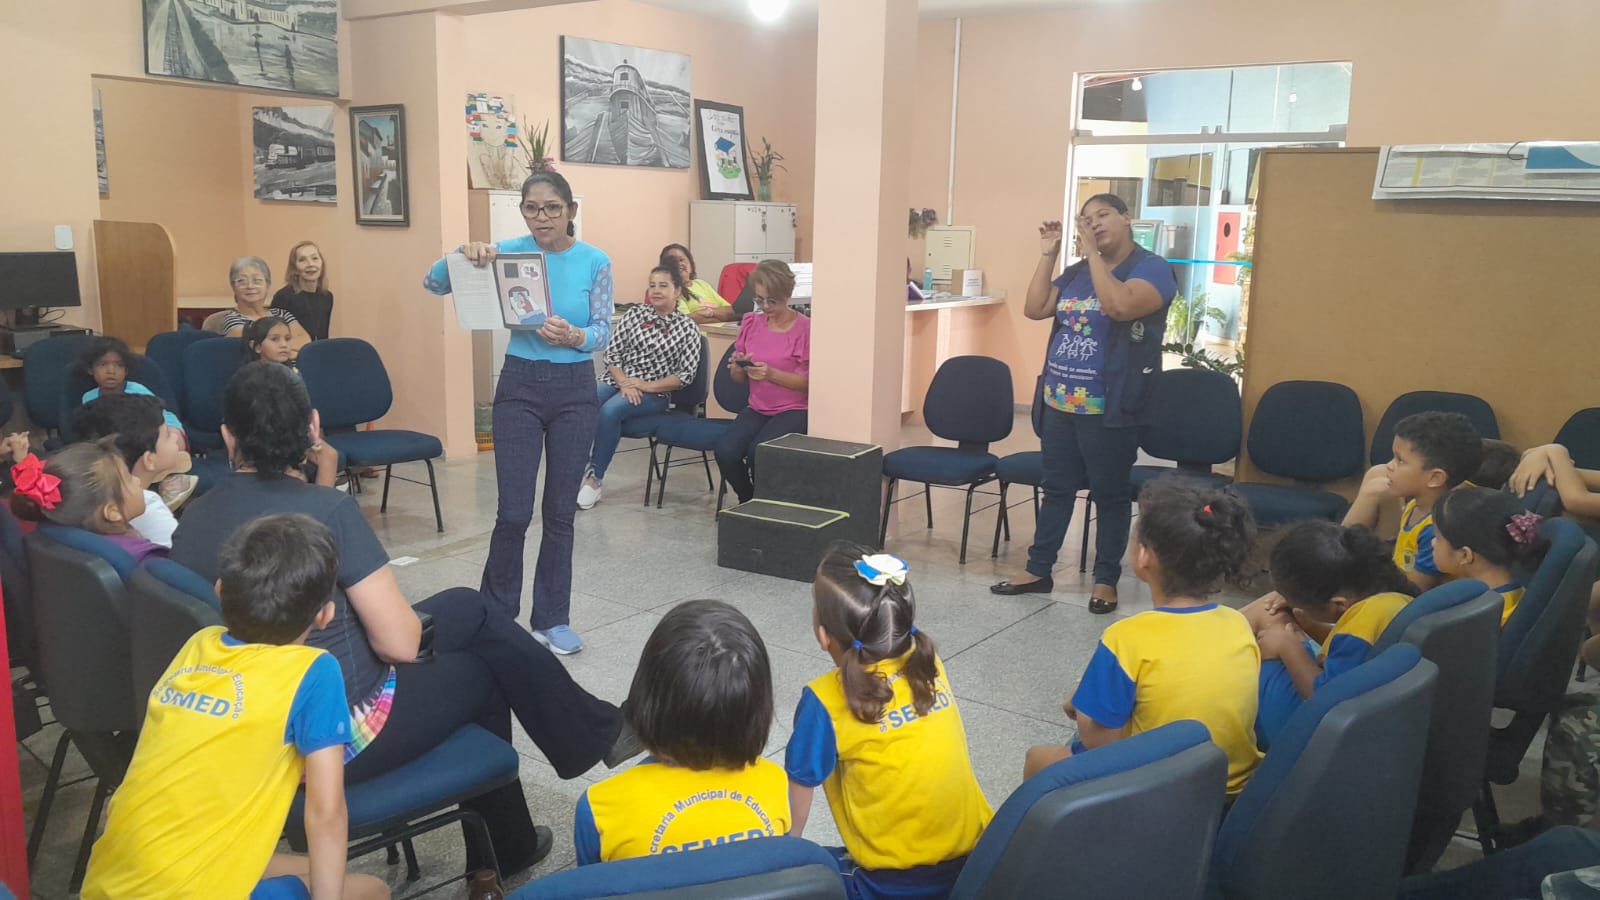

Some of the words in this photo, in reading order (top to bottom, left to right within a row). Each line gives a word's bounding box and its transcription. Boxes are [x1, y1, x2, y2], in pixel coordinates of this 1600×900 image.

[160, 687, 231, 717] SMED
[888, 693, 949, 728] SED
[649, 811, 675, 853] cretaria
[673, 789, 727, 812] Municipal
[730, 791, 742, 802] de
